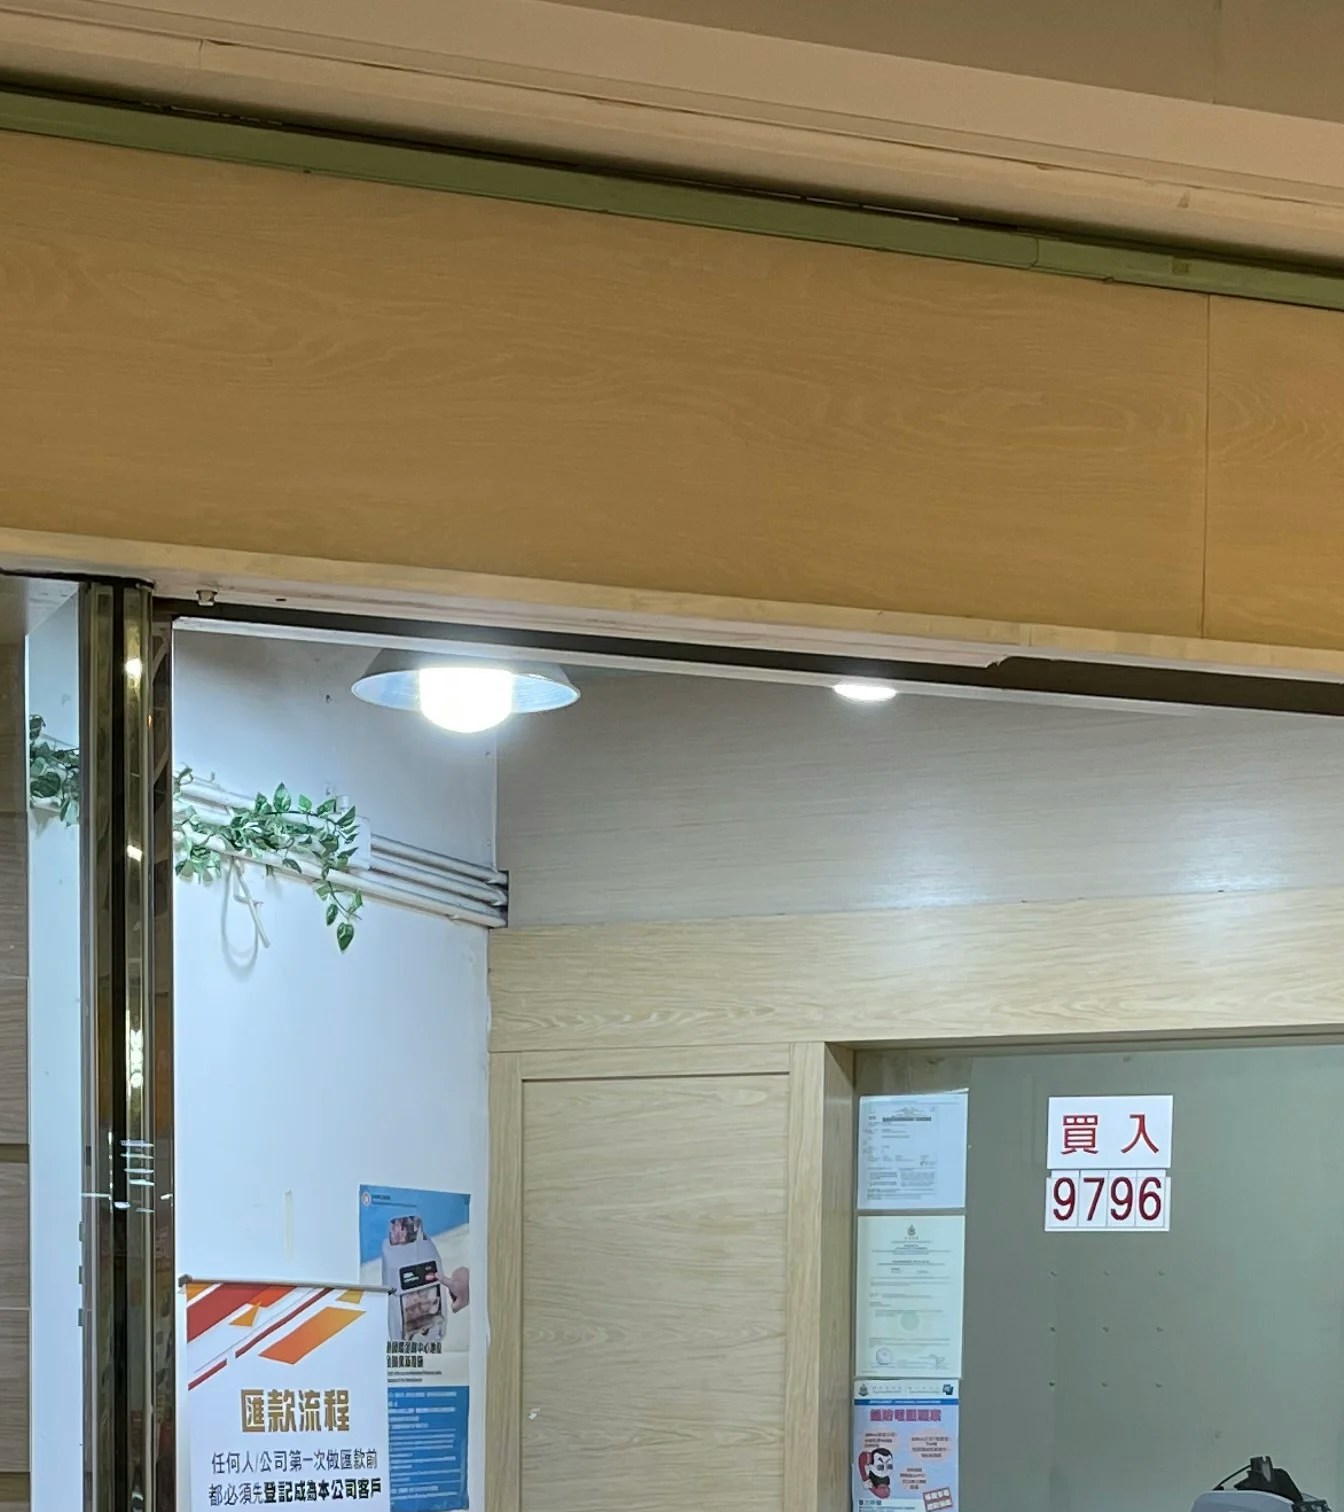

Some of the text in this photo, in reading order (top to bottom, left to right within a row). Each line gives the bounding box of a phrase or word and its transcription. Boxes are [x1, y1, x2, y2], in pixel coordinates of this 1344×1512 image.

[1061, 1113, 1159, 1154] 買入
[1053, 1176, 1162, 1221] 9796
[240, 1389, 350, 1433] 匯款流程
[211, 1447, 378, 1475] 任何人/公司第一次做匯款前
[208, 1477, 382, 1507] 都必須先登記成為本公司客戶
